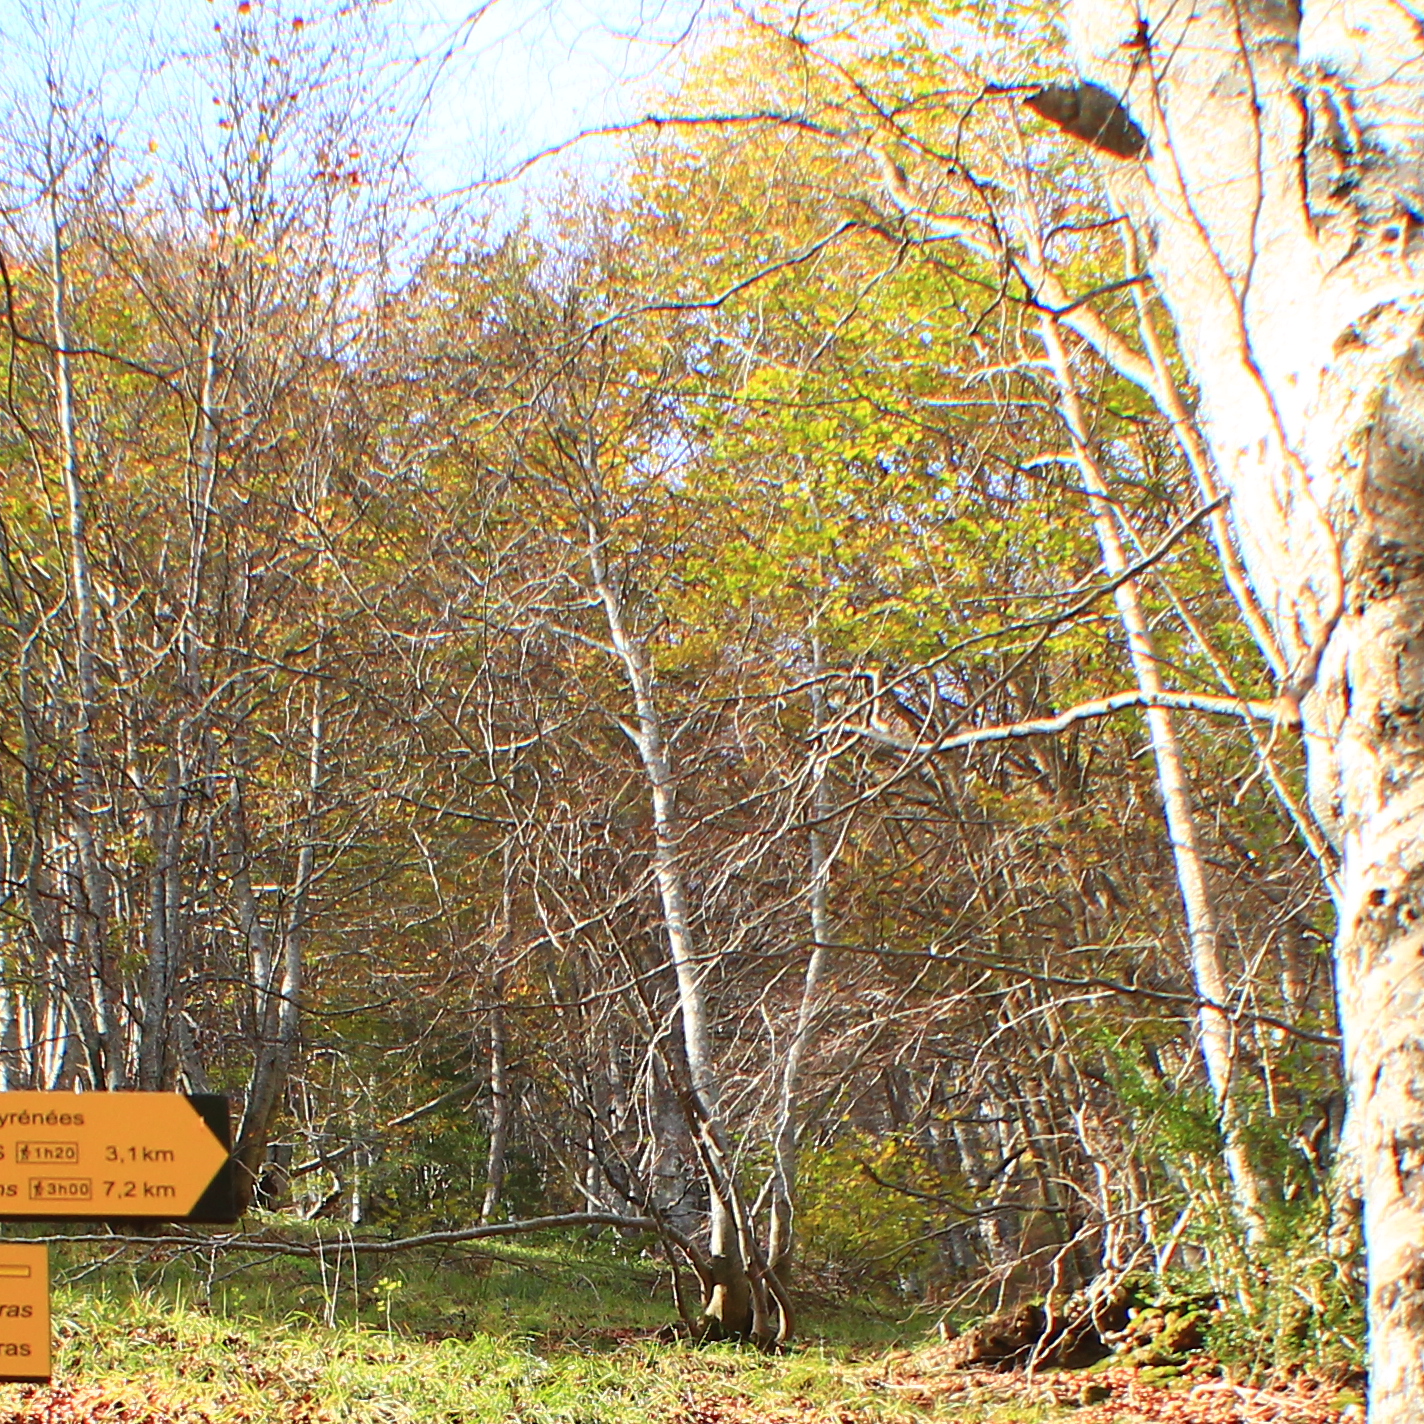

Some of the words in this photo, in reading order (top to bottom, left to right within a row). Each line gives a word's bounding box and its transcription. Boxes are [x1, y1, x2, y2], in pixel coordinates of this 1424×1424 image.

[35, 1146, 75, 1159] 1h20
[104, 1145, 137, 1164] 3,1
[142, 1145, 175, 1163] km
[46, 1182, 90, 1196] 3h00
[103, 1180, 137, 1200] 7,2
[143, 1181, 176, 1198] km
